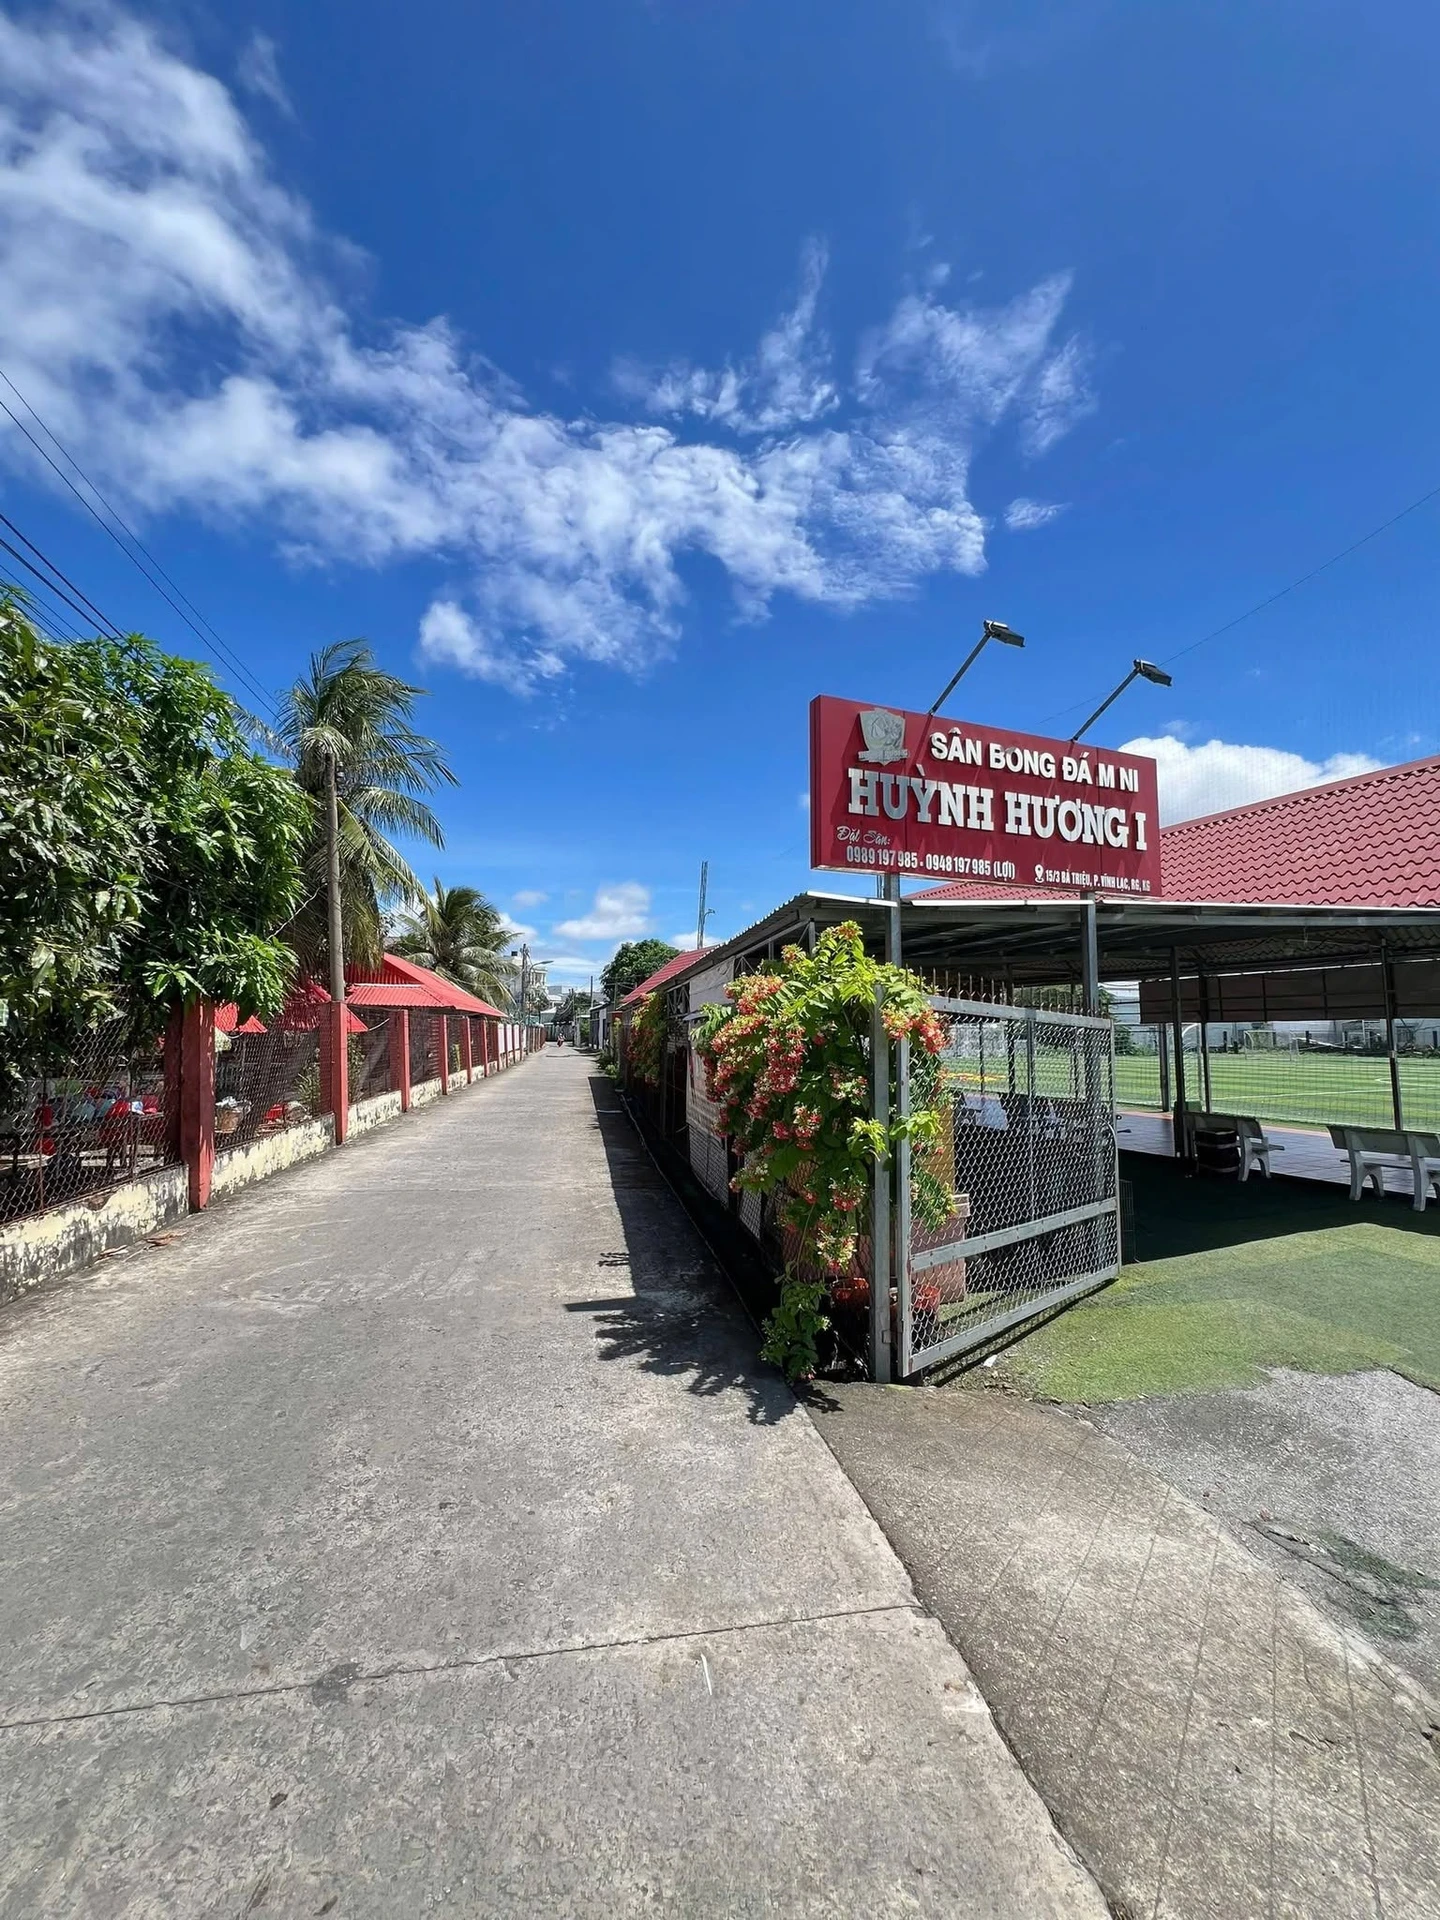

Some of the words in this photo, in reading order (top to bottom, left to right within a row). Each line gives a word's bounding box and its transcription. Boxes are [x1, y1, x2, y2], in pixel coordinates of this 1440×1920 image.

[930, 727, 983, 766] SÂN
[1061, 751, 1094, 785] ĐÁ
[848, 763, 995, 831] HUỲNH
[1004, 791, 1130, 849] HƯƠNG
[1135, 811, 1148, 851] I
